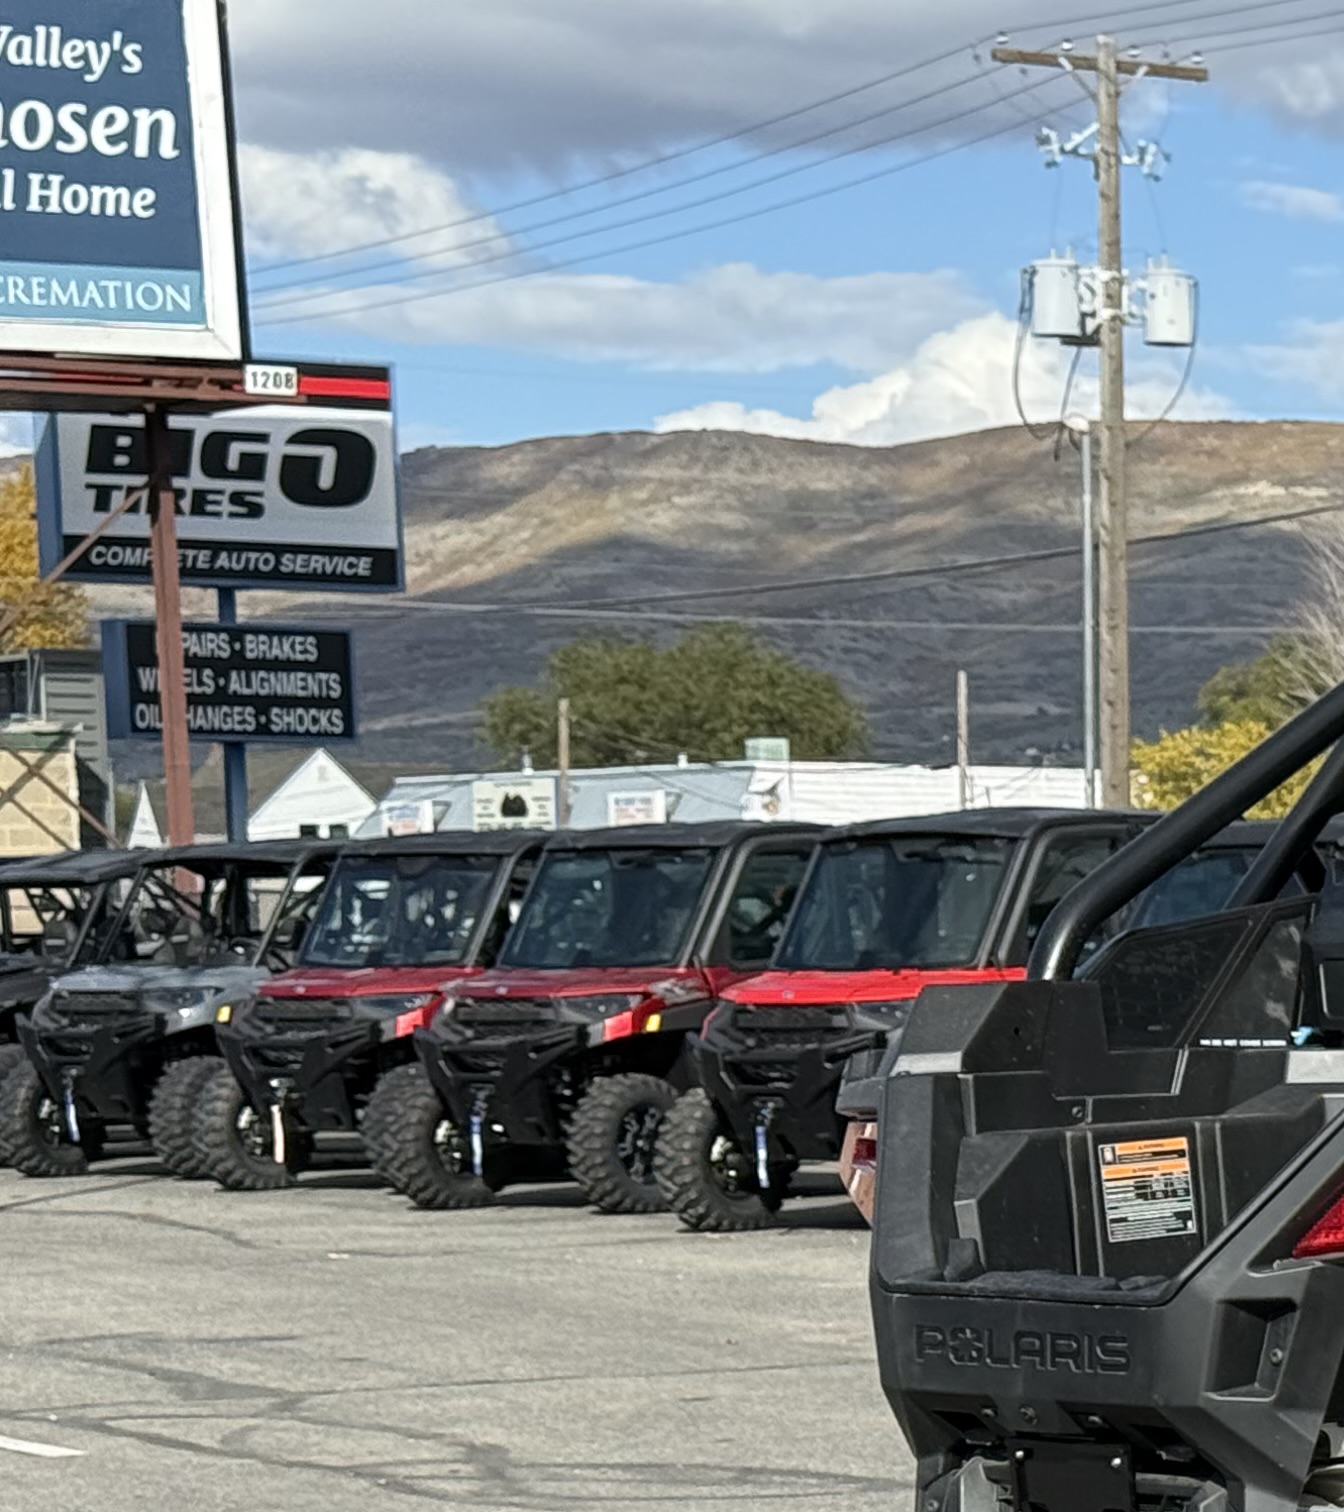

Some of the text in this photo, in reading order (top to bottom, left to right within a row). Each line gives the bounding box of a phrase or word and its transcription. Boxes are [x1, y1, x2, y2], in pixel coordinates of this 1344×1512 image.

[0, 98, 181, 160] osen
[26, 172, 156, 219] Home
[0, 275, 191, 312] REMATION
[251, 370, 295, 391] 1208
[213, 550, 276, 573] AUTO
[278, 552, 373, 577] SERVICE
[156, 630, 319, 663] PAIRS BRAKES
[137, 666, 342, 700] WELS ALIGNMENTS
[185, 704, 257, 733] HANGES
[269, 706, 344, 735] SHOCKS
[913, 1323, 1132, 1377] POLARIS
